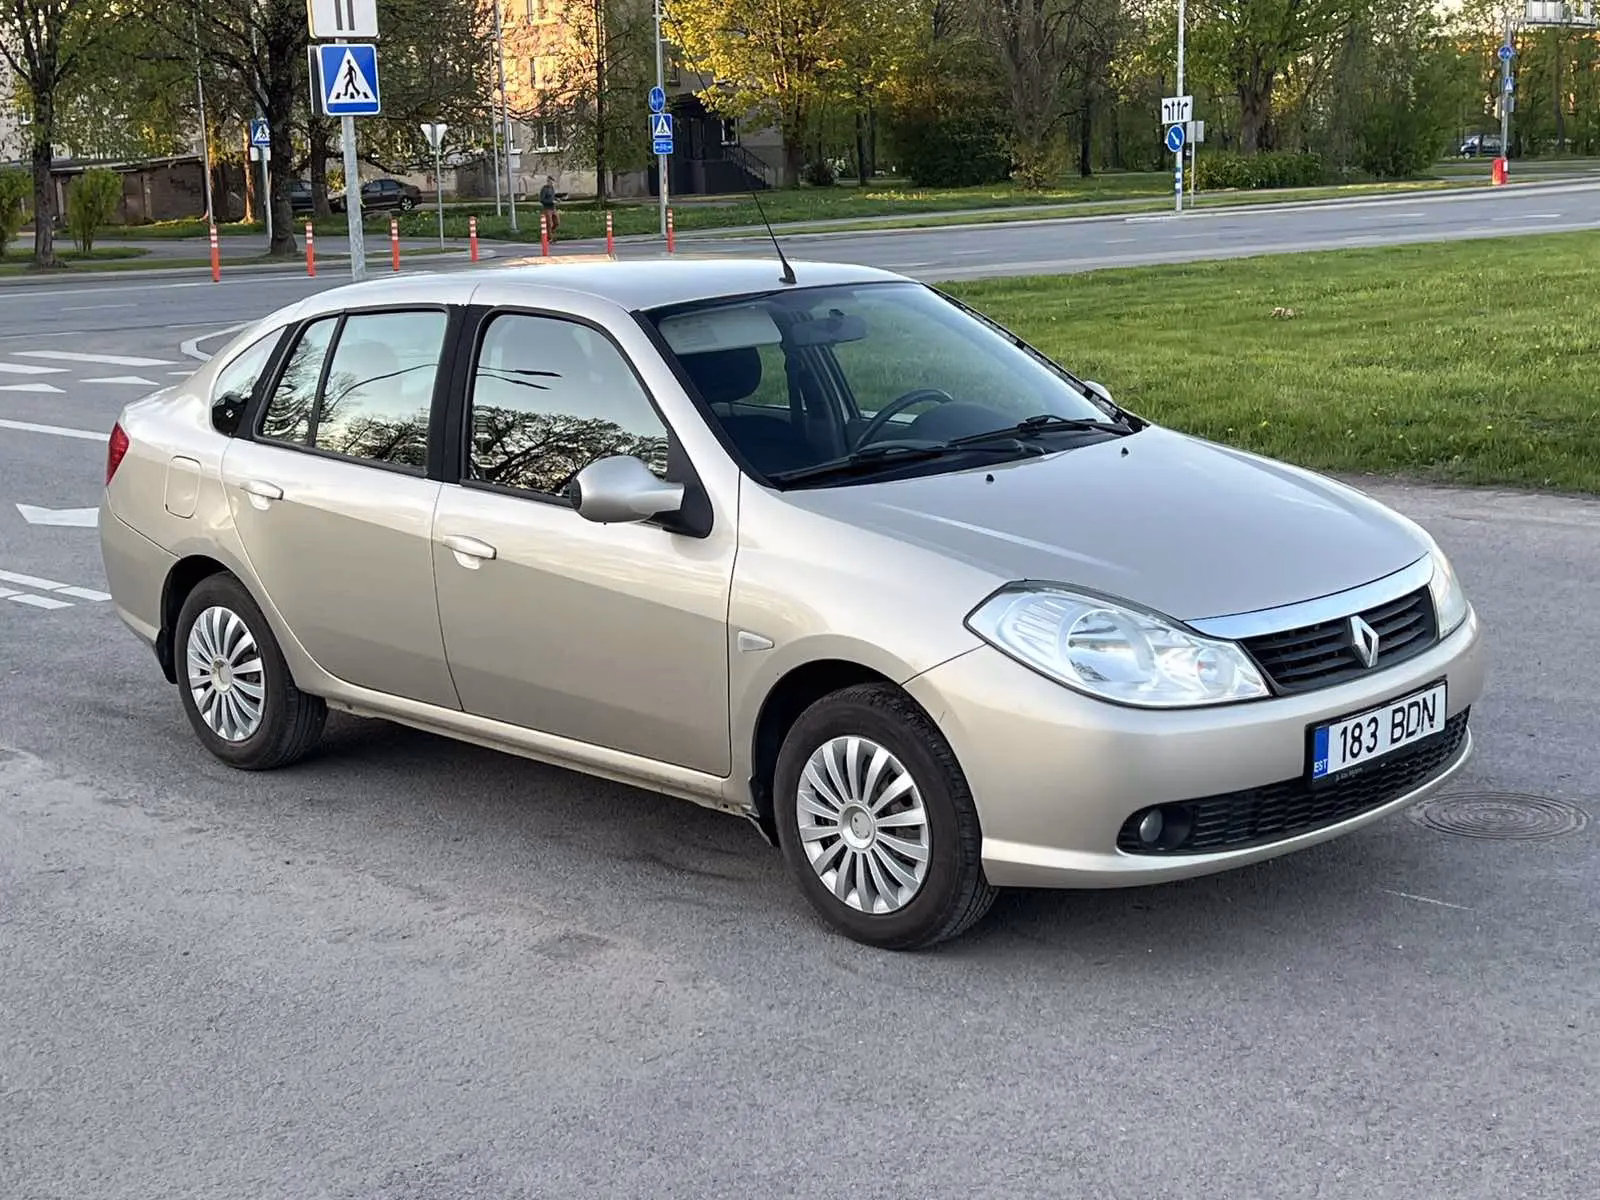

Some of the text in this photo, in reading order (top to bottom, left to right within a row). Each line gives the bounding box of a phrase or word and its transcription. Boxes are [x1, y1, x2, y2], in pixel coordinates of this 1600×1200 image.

[1340, 693, 1436, 763] 183 BDN
[1314, 759, 1328, 773] EST
